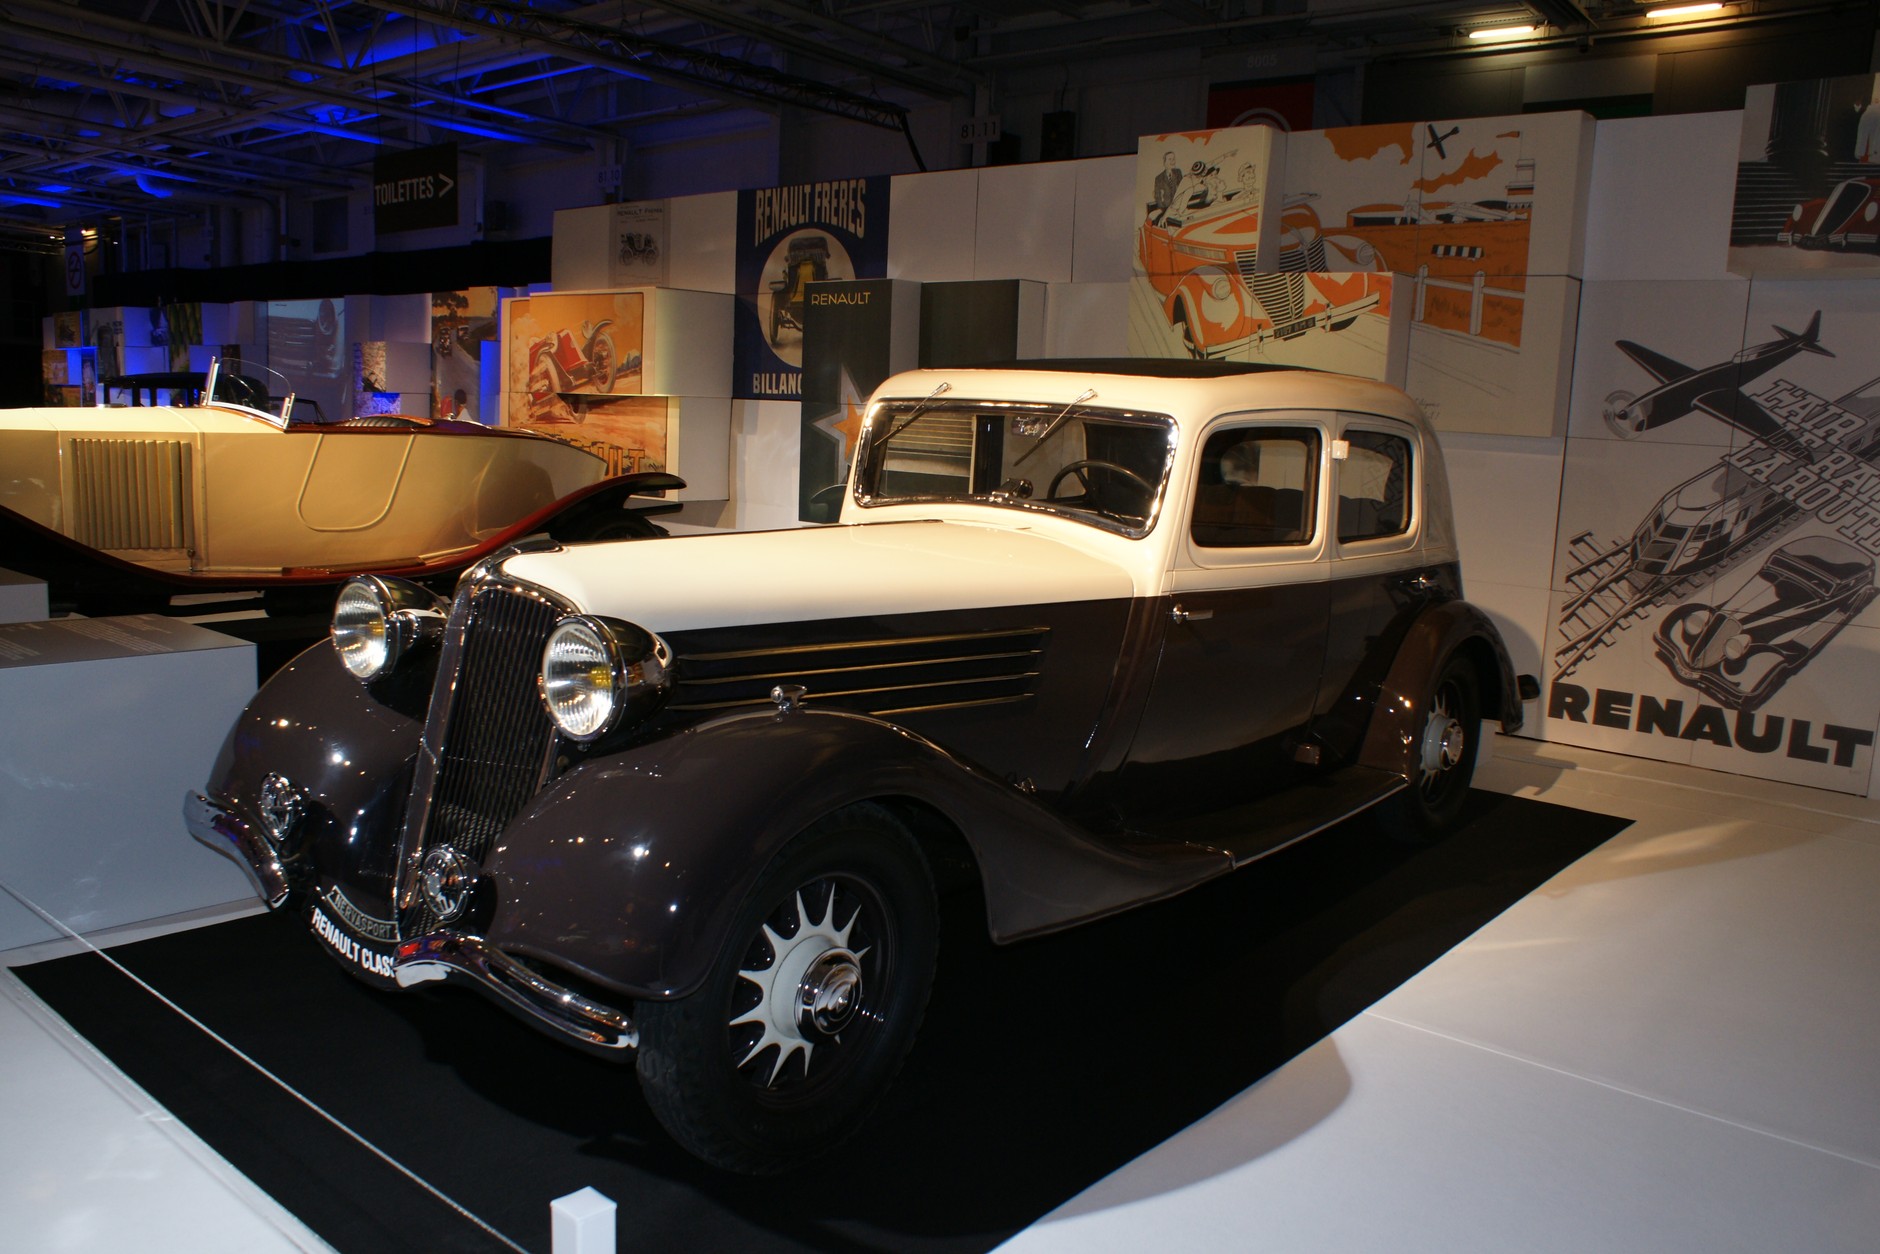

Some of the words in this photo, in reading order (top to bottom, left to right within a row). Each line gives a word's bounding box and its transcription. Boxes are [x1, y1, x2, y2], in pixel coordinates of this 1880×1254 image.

[961, 121, 996, 139] 81.11
[374, 175, 434, 206] TOILETTES
[755, 187, 811, 248] RENAULT
[814, 178, 867, 240] FRERES
[811, 292, 871, 306] RENAULT
[1719, 435, 1794, 485] LA
[1805, 449, 1880, 512] RAI
[1548, 681, 1875, 768] RENAULT
[312, 906, 360, 963] RENAULT
[333, 893, 393, 939] NERVASPORT
